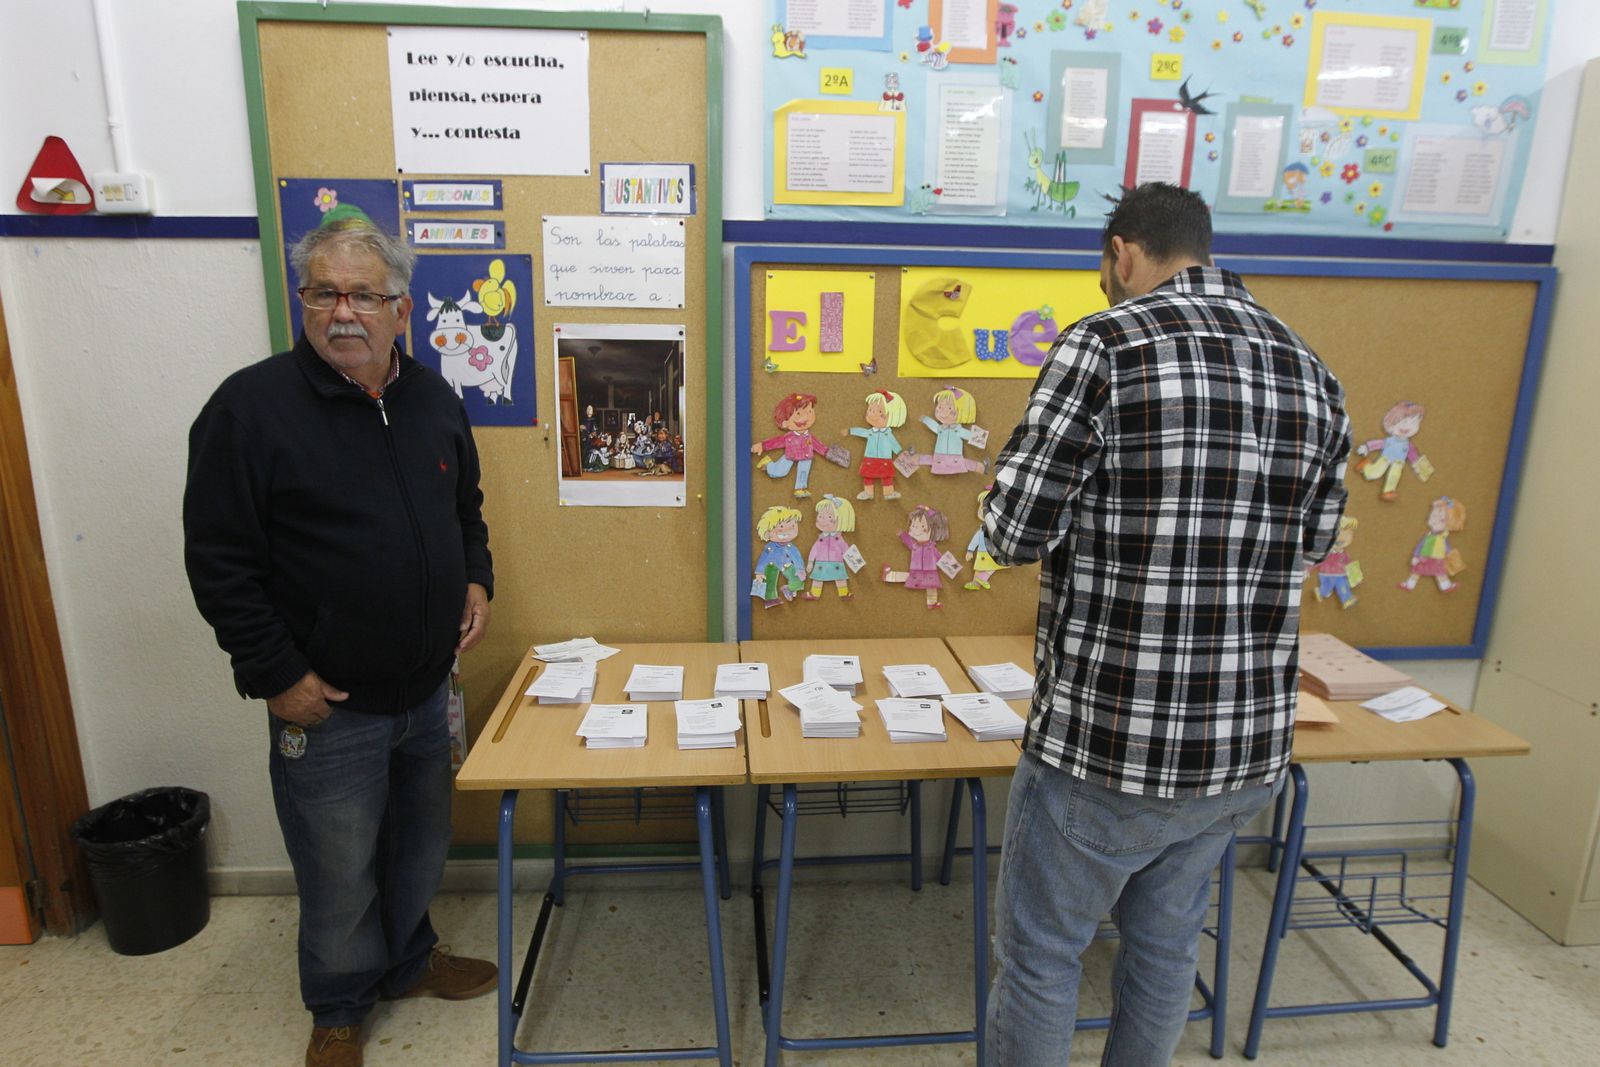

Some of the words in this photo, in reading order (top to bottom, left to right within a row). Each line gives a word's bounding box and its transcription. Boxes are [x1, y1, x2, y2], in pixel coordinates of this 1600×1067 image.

[407, 51, 438, 66] Lee
[446, 52, 476, 69] y/o
[484, 54, 565, 70] escucha,
[824, 74, 849, 87] 2ºA
[409, 88, 477, 104] piensa,
[481, 91, 542, 104] espera
[411, 126, 440, 139] y...
[444, 126, 521, 140] contesta
[418, 189, 490, 202] PERSONAS
[607, 177, 685, 205] SUSTANTIVOS
[419, 228, 489, 240] ANIMALES
[550, 225, 582, 246] Son
[595, 228, 622, 247] las
[549, 262, 578, 281] que
[588, 262, 636, 275] sirven
[641, 264, 683, 283] para
[554, 284, 638, 302] nombrar
[768, 291, 845, 354] El
